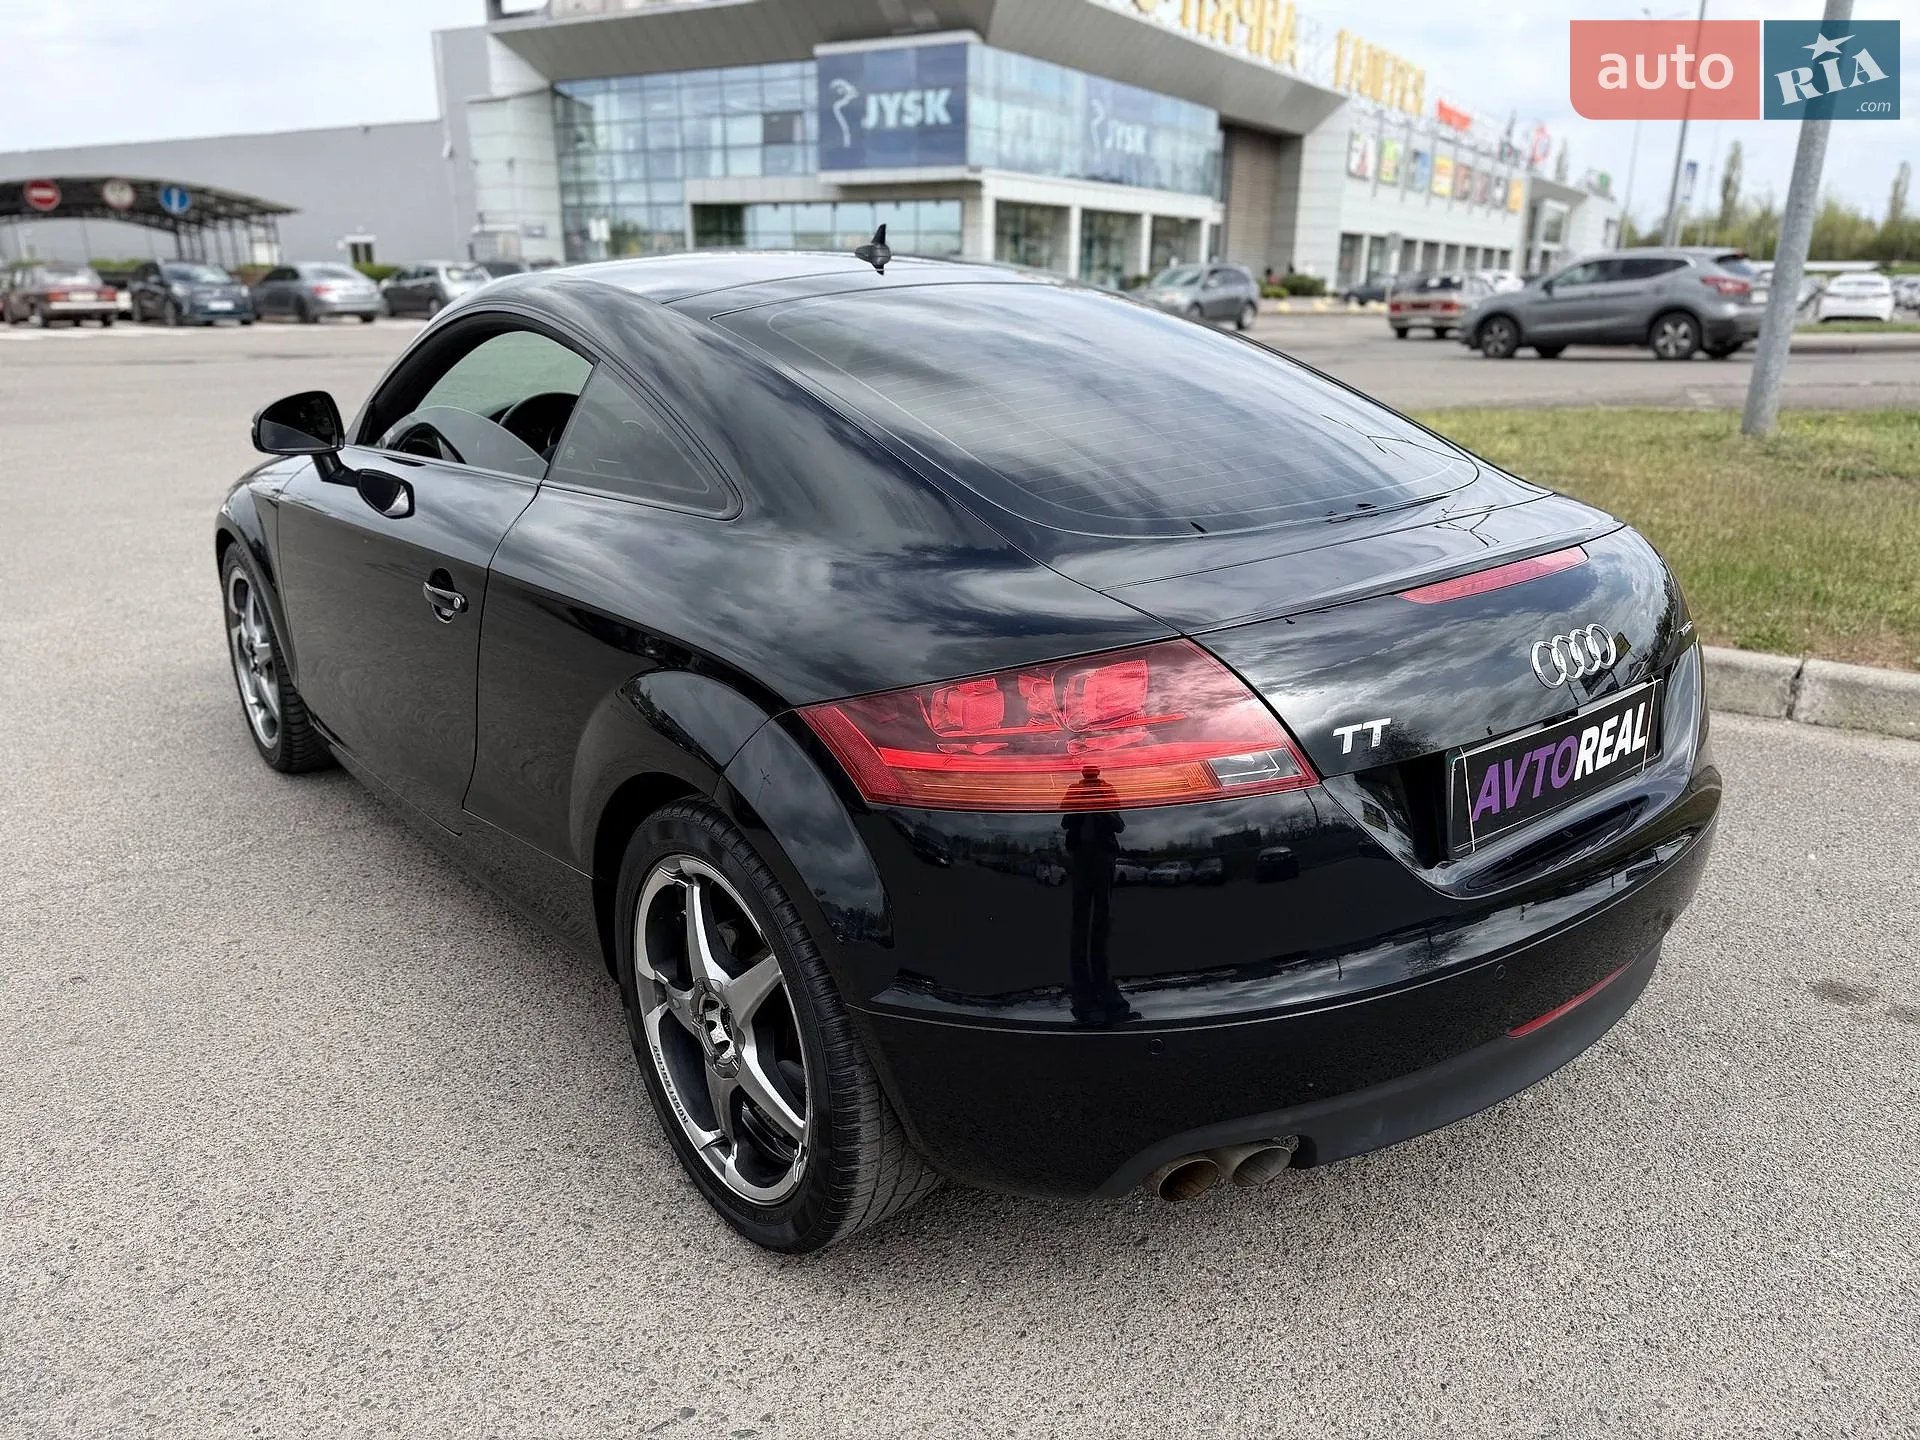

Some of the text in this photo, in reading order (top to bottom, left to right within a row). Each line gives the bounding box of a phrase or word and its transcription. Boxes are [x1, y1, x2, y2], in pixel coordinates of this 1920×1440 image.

[861, 88, 952, 129] JYSK
[1332, 717, 1392, 755] TT
[1471, 702, 1648, 822] AVTOREAL
